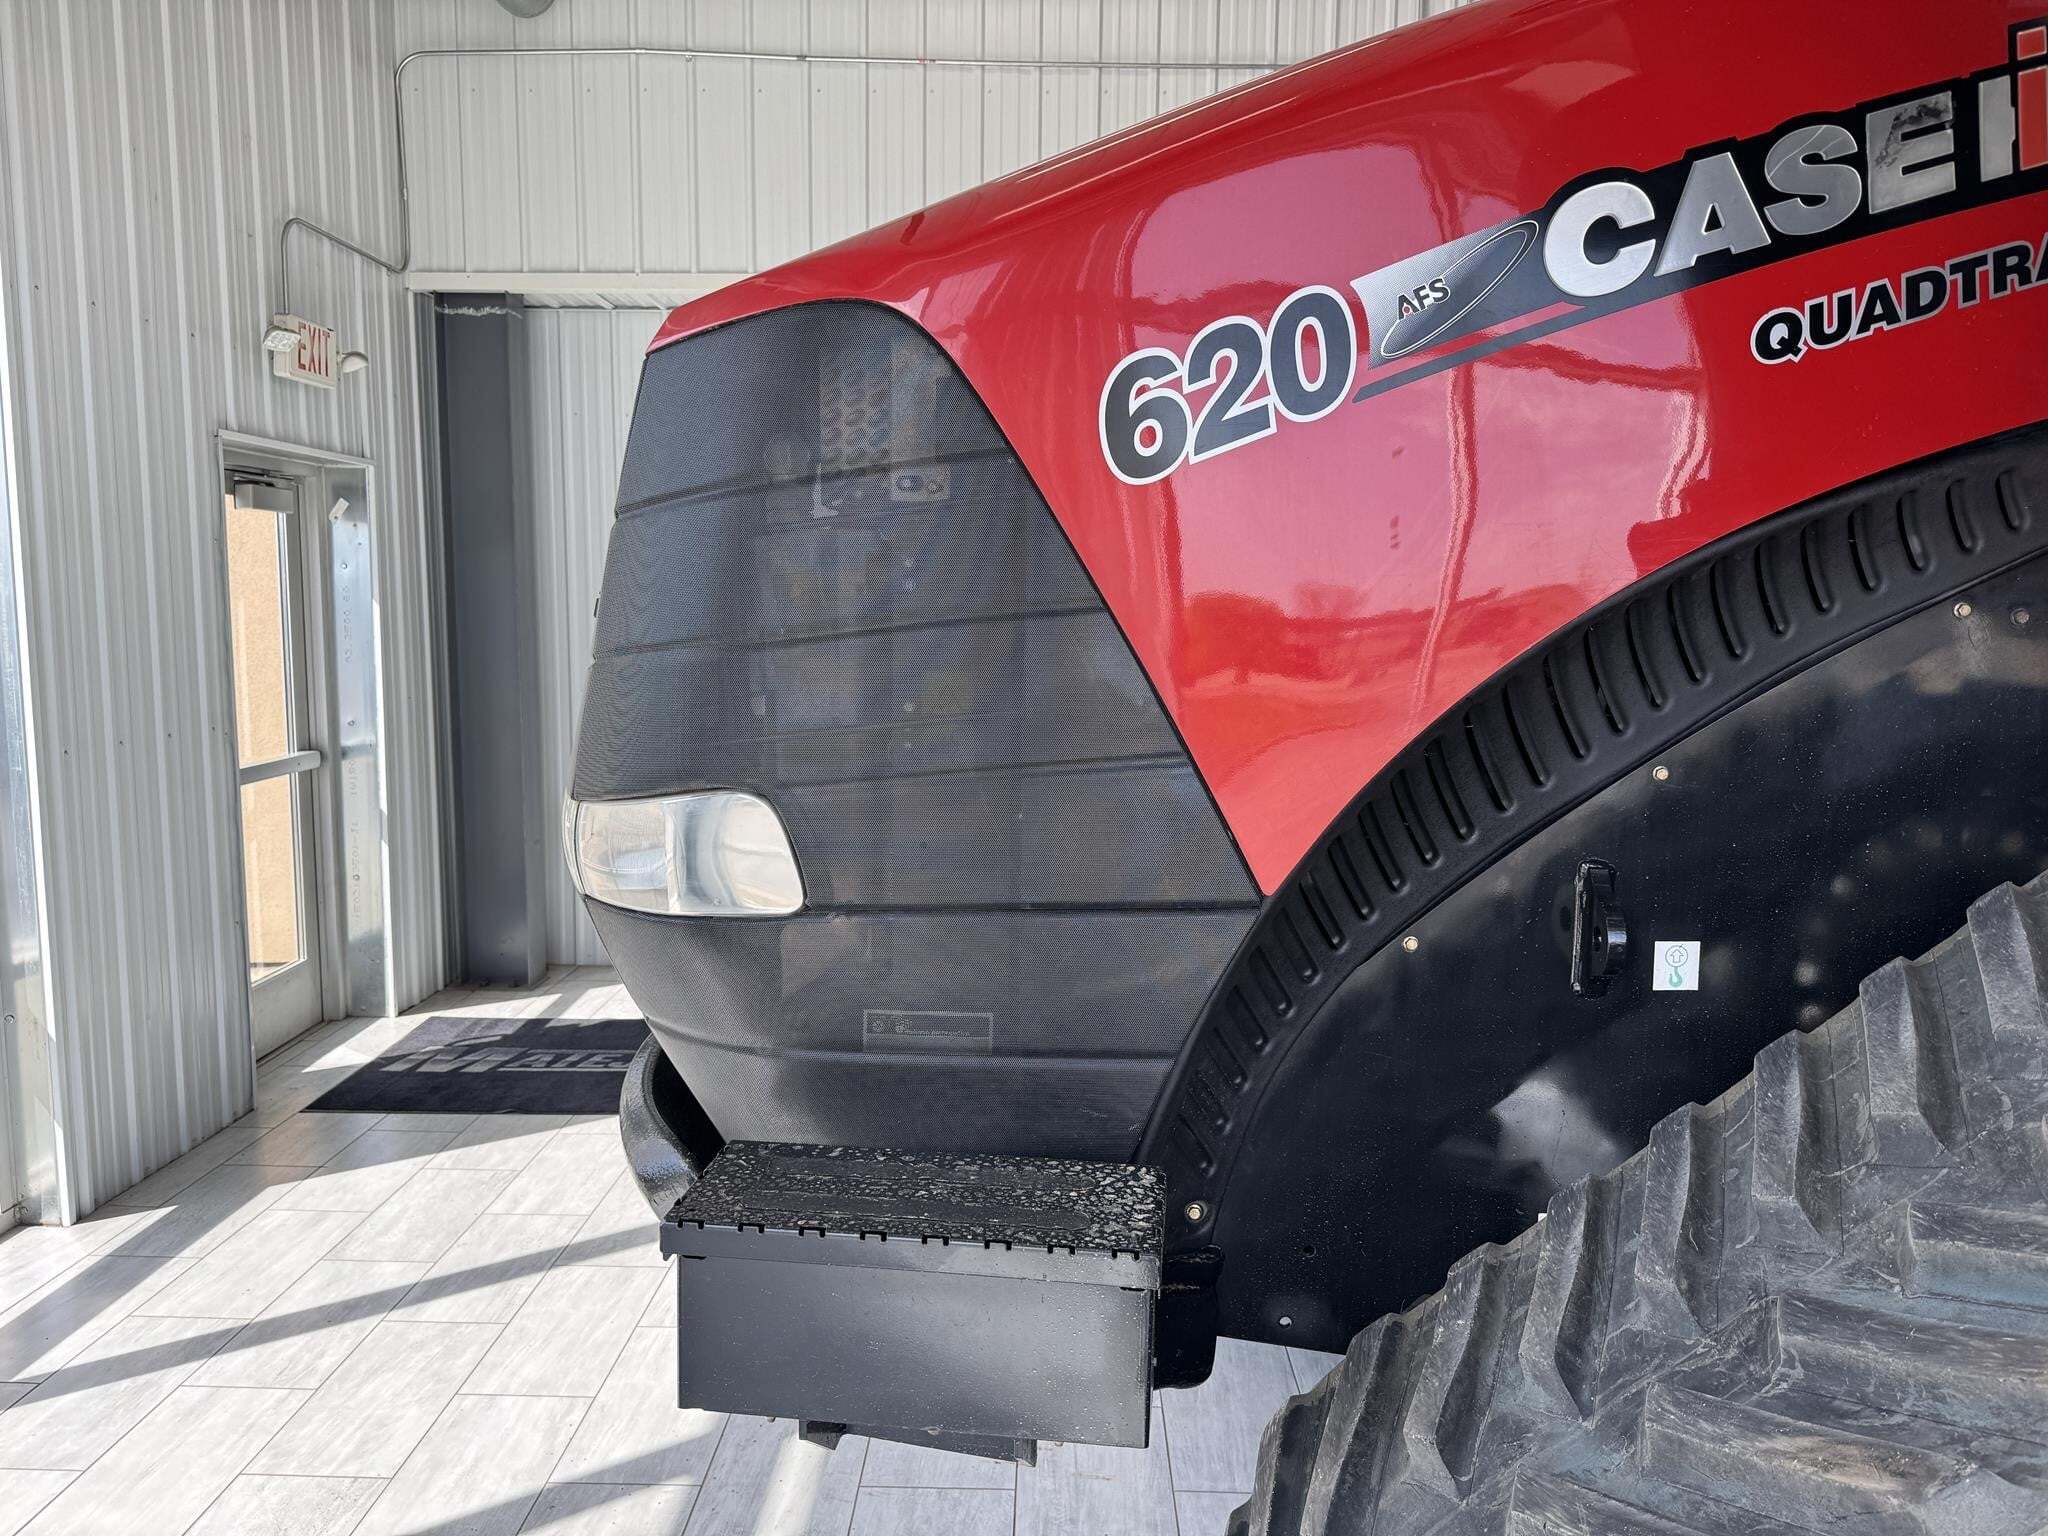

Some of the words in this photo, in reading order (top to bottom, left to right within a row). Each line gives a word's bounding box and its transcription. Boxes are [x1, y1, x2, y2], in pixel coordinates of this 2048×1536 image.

[1544, 90, 1956, 297] CASE
[297, 320, 331, 378] EXIT
[1397, 276, 1451, 321] AFS
[1099, 284, 1358, 485] 620
